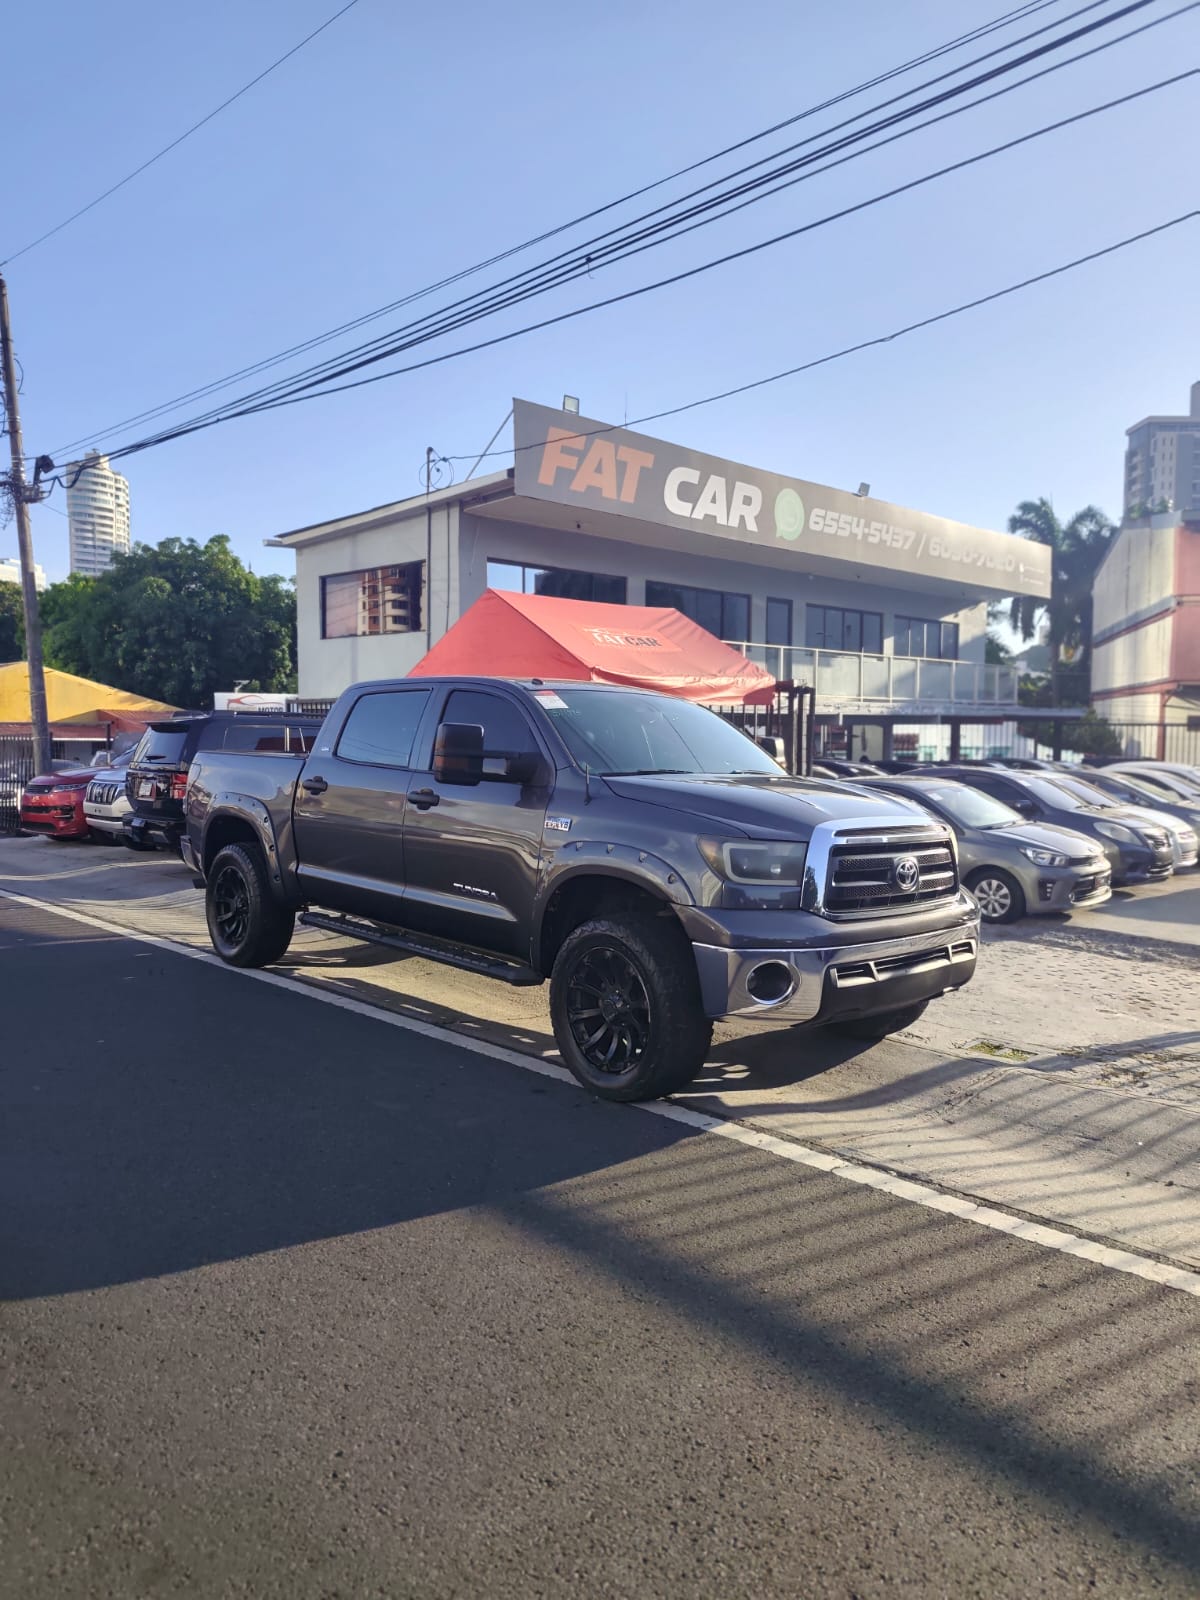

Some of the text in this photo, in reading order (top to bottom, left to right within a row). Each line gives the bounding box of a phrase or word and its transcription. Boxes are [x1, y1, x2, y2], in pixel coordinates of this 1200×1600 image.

[537, 425, 763, 532] FAT CAR
[808, 507, 916, 550] 6554-5437
